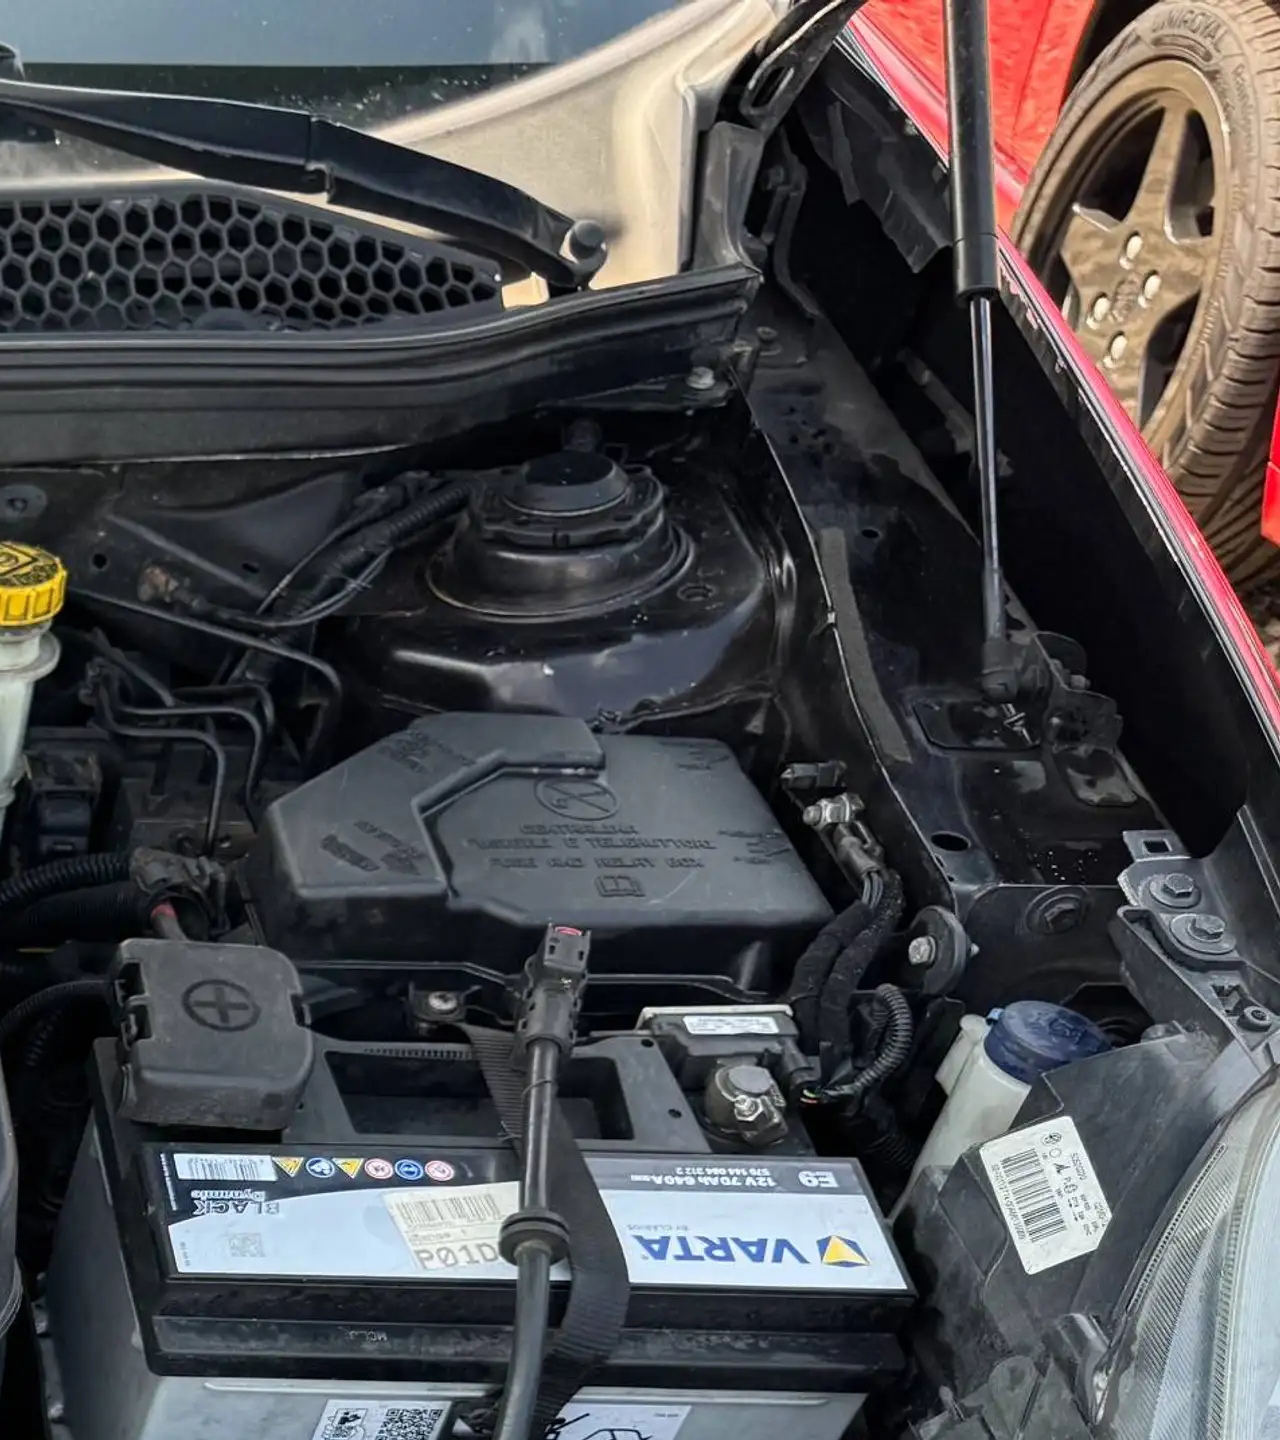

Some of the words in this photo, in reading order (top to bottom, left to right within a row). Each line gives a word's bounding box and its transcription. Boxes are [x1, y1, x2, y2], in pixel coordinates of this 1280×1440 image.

[744, 1175, 778, 1187] 12V
[797, 1170, 840, 1188] E9
[191, 1200, 280, 1216] BLACK
[631, 1234, 812, 1265] VARTA
